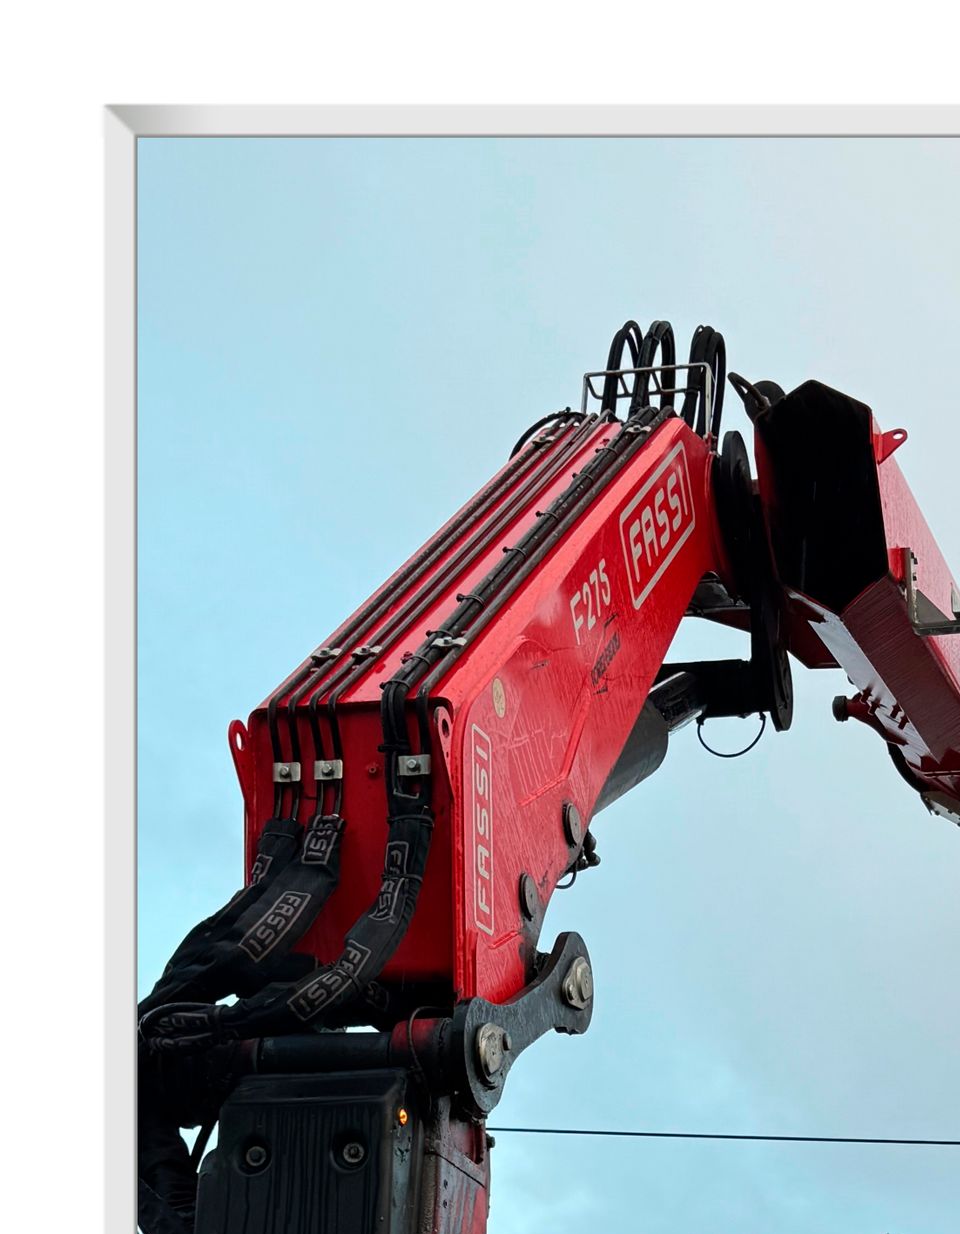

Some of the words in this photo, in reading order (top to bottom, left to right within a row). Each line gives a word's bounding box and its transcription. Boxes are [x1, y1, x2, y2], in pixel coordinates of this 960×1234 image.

[628, 464, 689, 583] FASSI
[569, 557, 612, 646] F275
[475, 747, 491, 915] FASSI
[248, 895, 302, 952] FASSI
